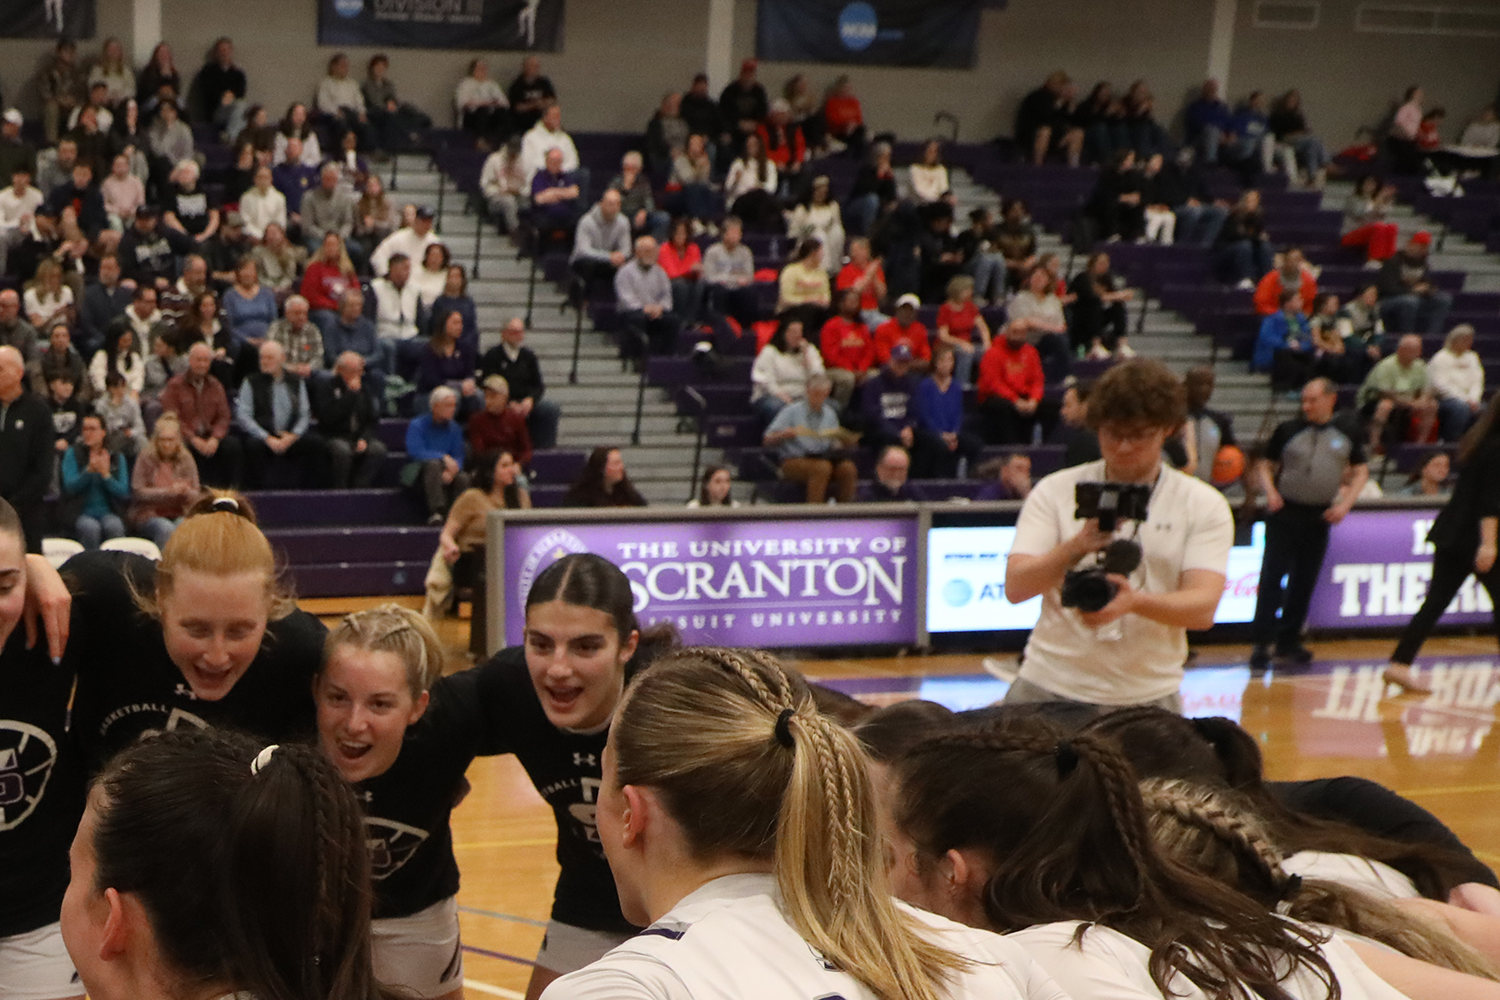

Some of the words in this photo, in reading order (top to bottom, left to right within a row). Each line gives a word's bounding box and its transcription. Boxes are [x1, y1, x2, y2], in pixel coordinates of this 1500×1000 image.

[616, 541, 679, 560] THE
[688, 537, 863, 558] UNIVERSITY
[870, 536, 907, 554] OF
[620, 555, 907, 614] SCRANTON
[1332, 561, 1435, 617] THE
[752, 608, 902, 629] UNIVERSITY
